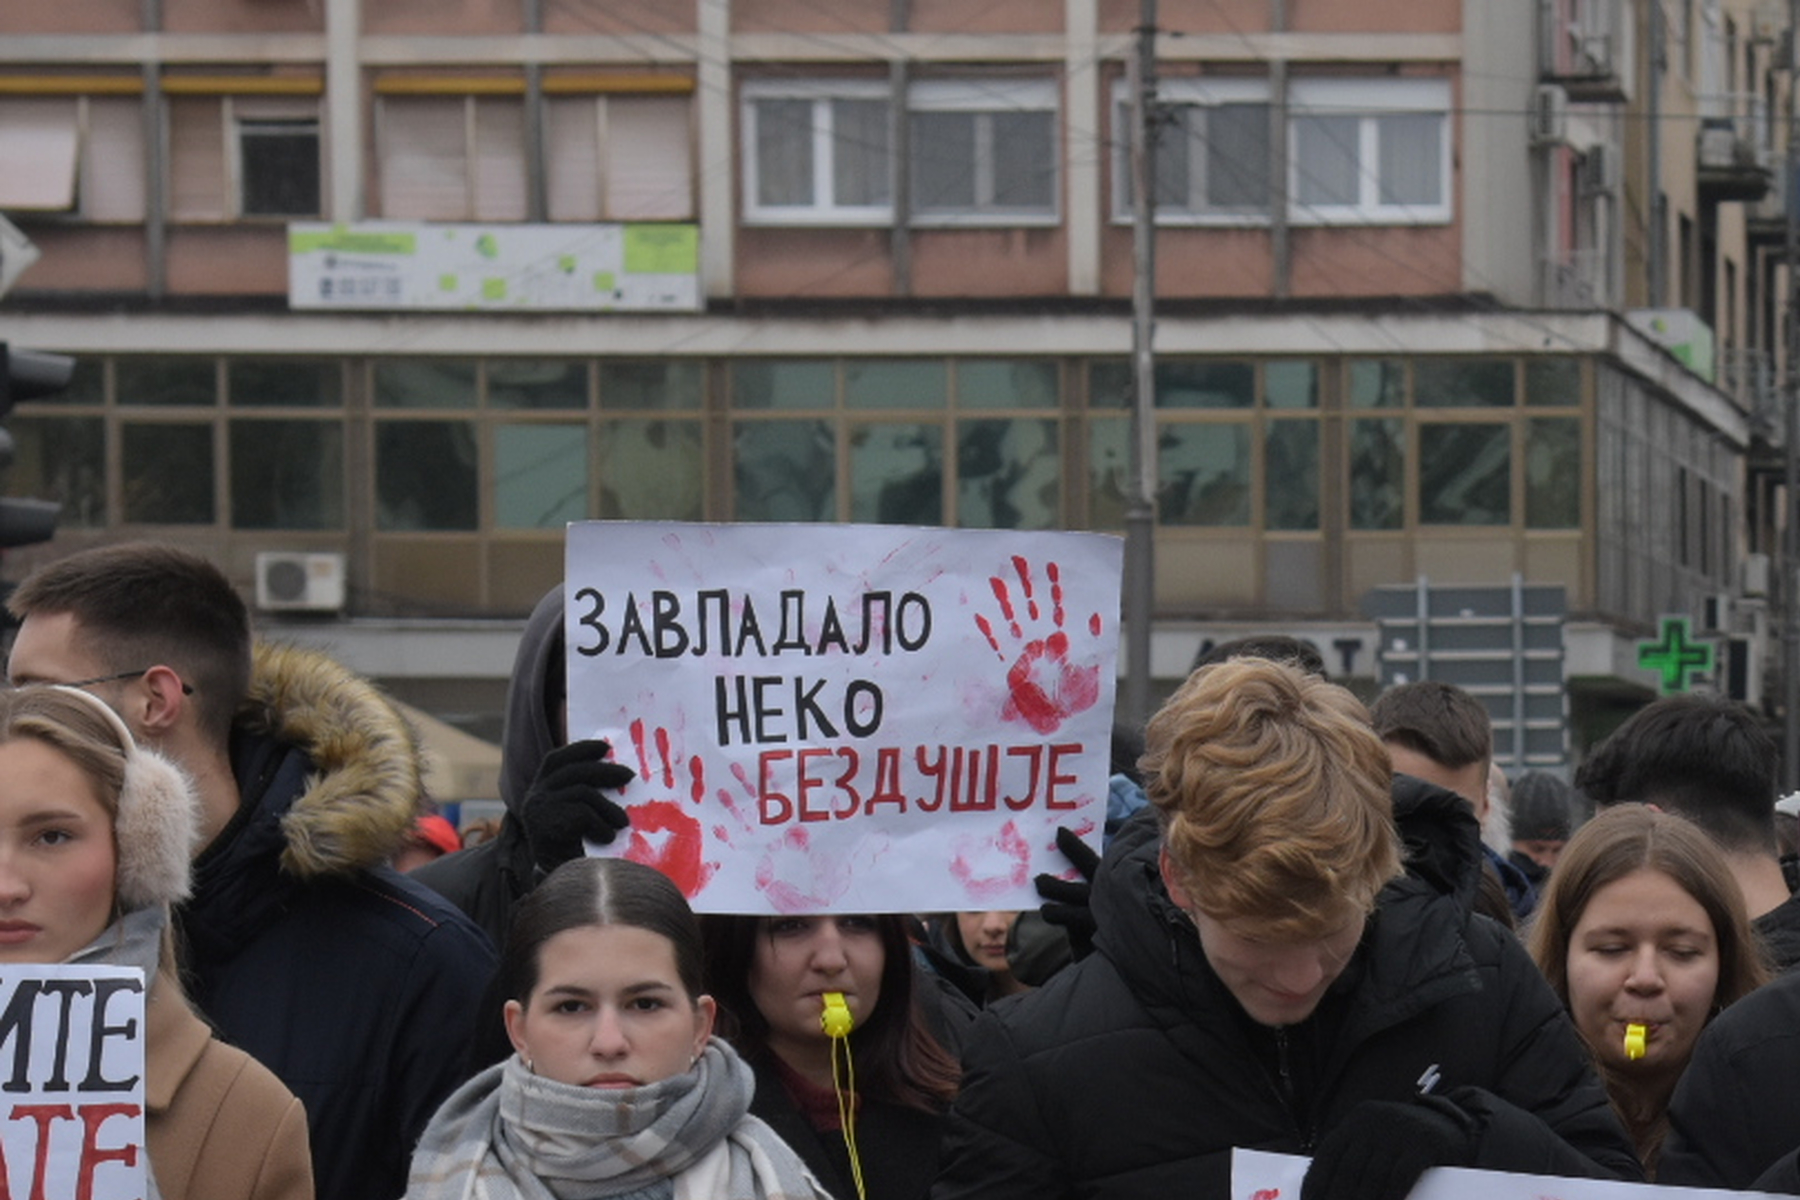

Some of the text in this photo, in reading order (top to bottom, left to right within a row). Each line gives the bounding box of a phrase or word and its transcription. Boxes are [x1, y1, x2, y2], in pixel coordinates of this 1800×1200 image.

[574, 587, 932, 658] ЗАВЛАДАЛО
[714, 675, 885, 746] НЕКО
[758, 743, 1084, 825] БЕЗДУШЈЕ
